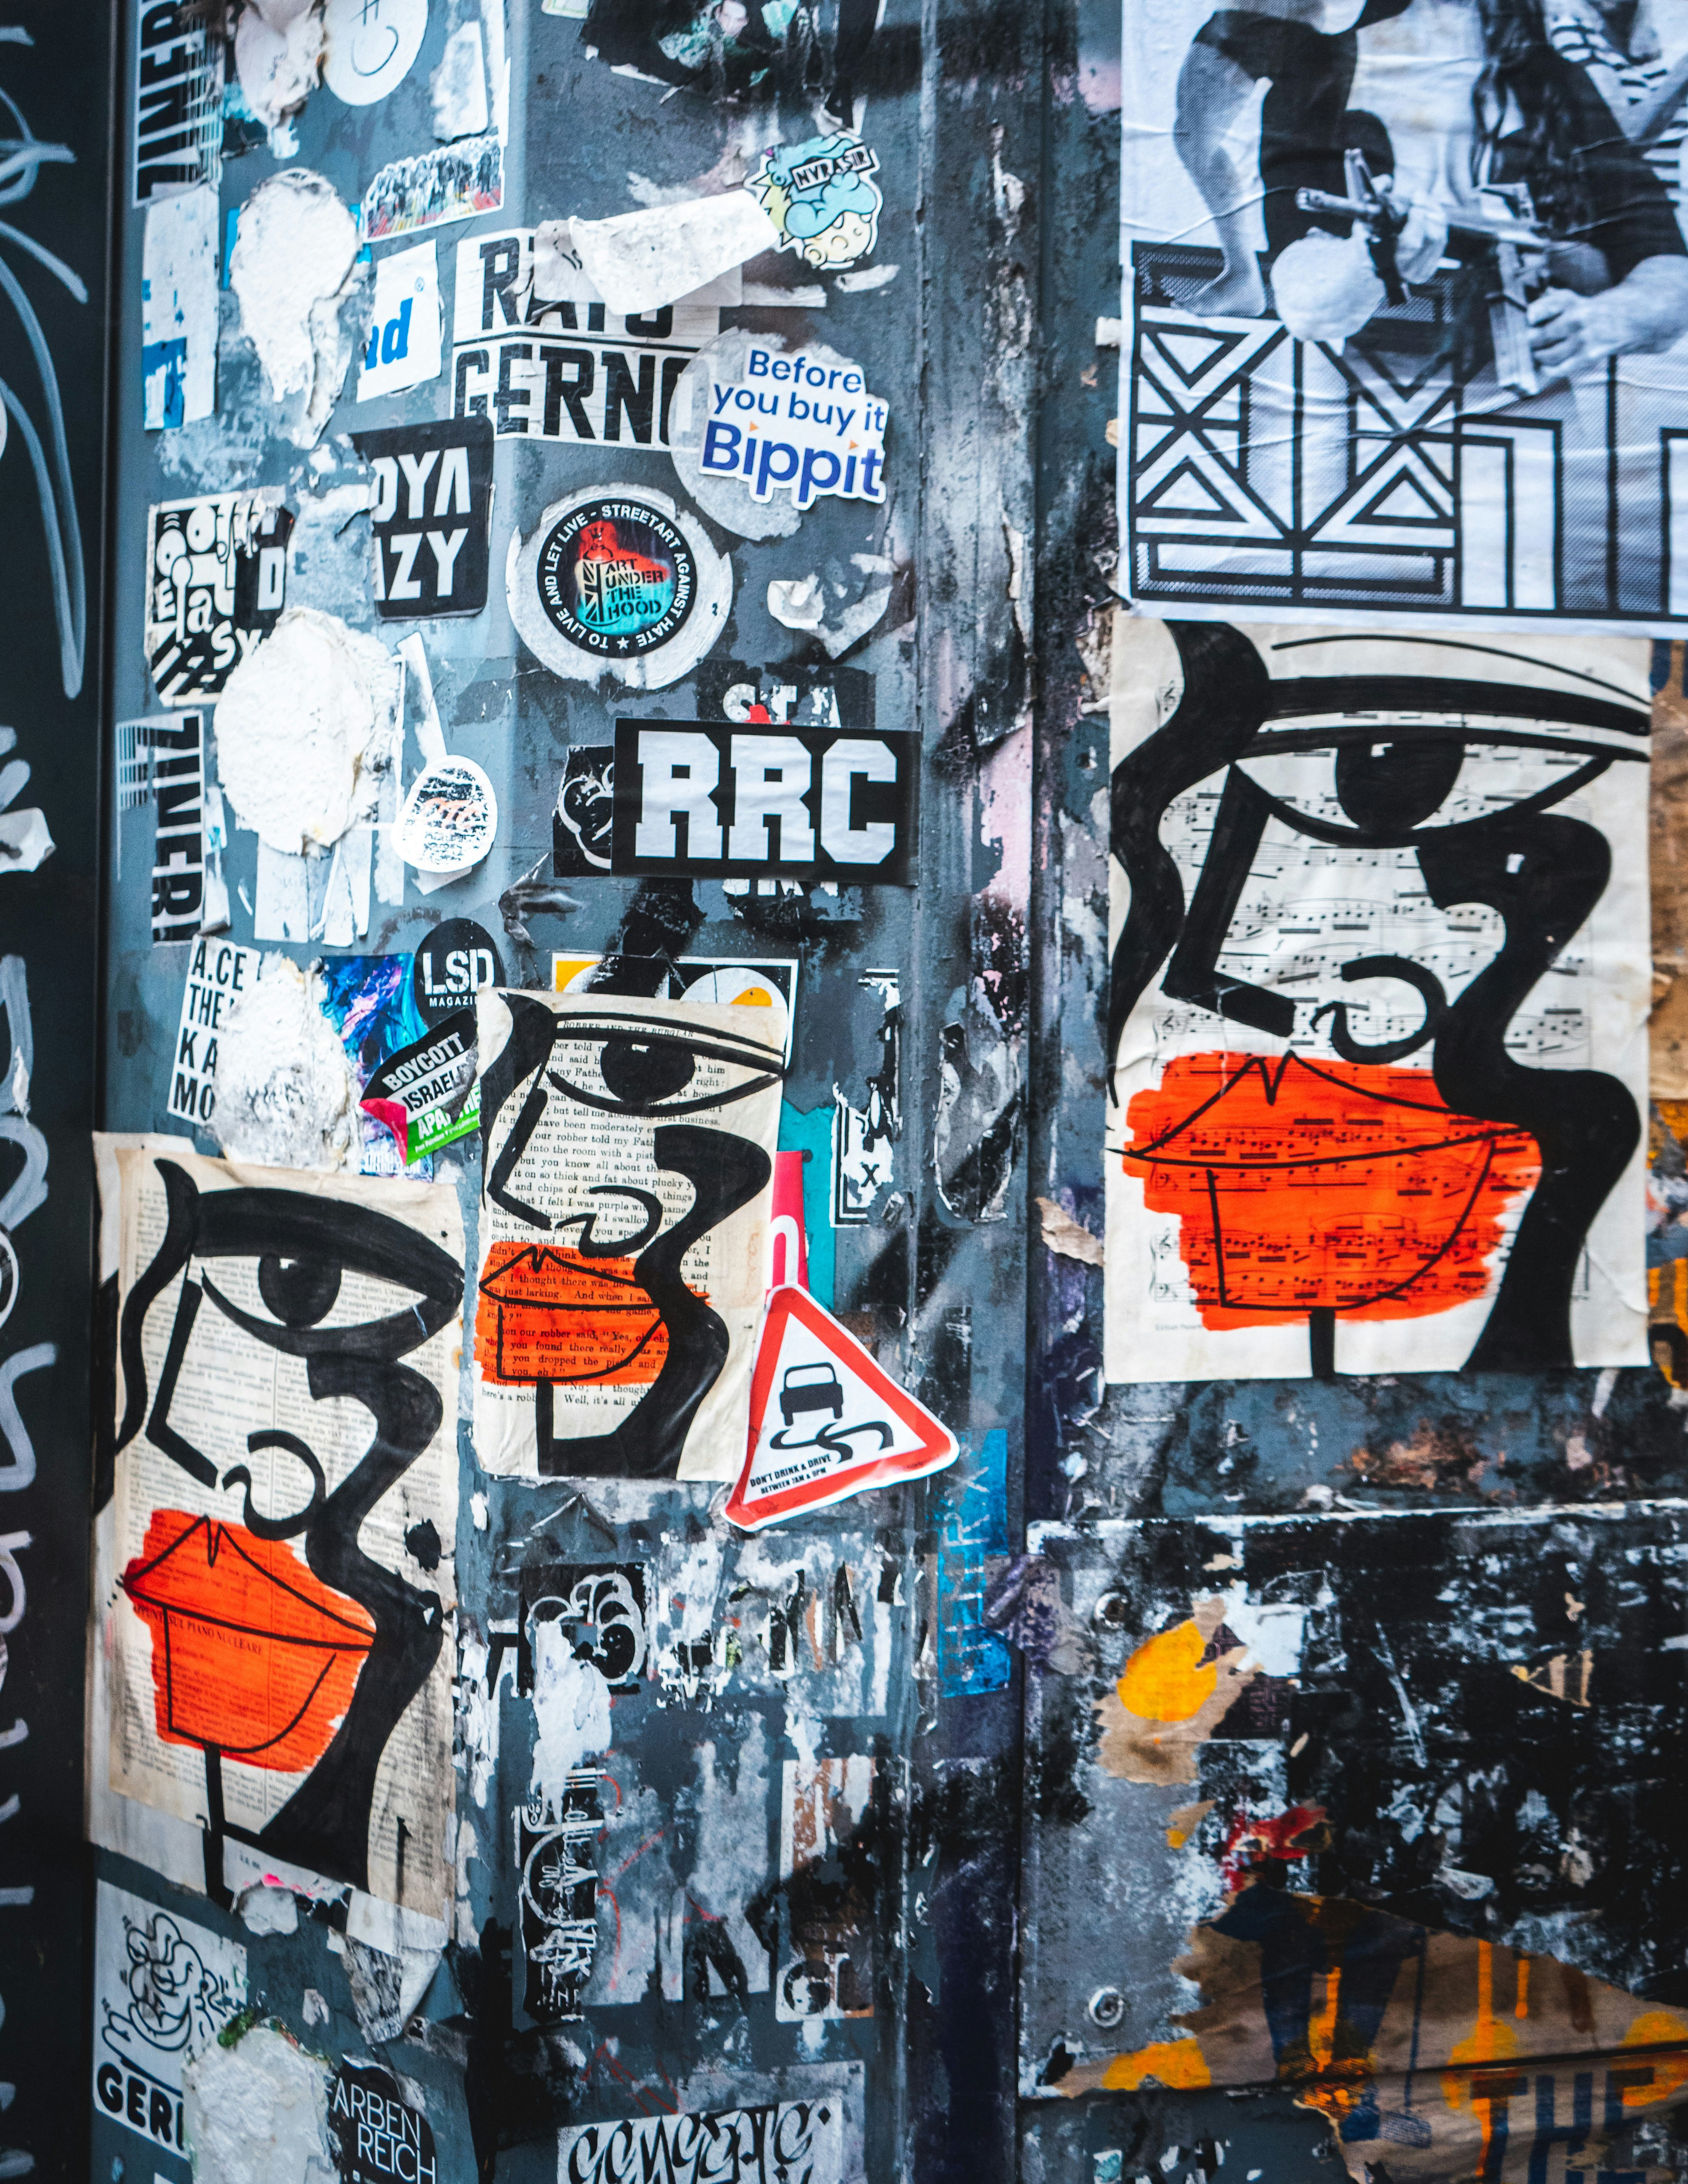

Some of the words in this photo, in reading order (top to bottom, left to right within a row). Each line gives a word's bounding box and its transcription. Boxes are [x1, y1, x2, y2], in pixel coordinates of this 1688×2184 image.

[749, 349, 862, 393] Before
[714, 383, 779, 415] you
[788, 391, 856, 437] buy
[864, 402, 885, 432] it
[703, 420, 884, 503] Bippit
[557, 512, 589, 543] LIVE
[601, 504, 682, 549] STREETART
[544, 541, 563, 572] LET
[605, 558, 638, 575] ART
[606, 569, 664, 589] UNDER
[670, 552, 691, 619] AGAINST
[544, 575, 563, 606] AND
[607, 586, 641, 603] THE
[608, 600, 661, 619] HOOD
[556, 607, 587, 639] LIVE
[635, 617, 674, 647] HATE
[588, 634, 609, 649] TO
[635, 730, 897, 864] RRC
[423, 948, 495, 995] LSD
[574, 1042, 592, 1051] told
[382, 1032, 465, 1092] BOYCOTT
[569, 1054, 588, 1063] said
[575, 1067, 602, 1077] Fathe
[707, 1064, 725, 1073] him
[582, 1081, 593, 1090] he
[550, 1094, 567, 1102] can
[498, 1114, 506, 1123] It
[564, 1119, 585, 1129] been
[590, 1121, 644, 1135] moderately
[554, 1106, 569, 1115] but
[573, 1107, 589, 1116] tell
[679, 1114, 721, 1126] business.
[556, 1132, 587, 1143] robber
[592, 1135, 610, 1144] told
[614, 1138, 629, 1147] my
[633, 1137, 655, 1147] Fath
[530, 1143, 549, 1152] into
[553, 1144, 568, 1154] the
[601, 1149, 621, 1158] with
[541, 1159, 559, 1168] you
[565, 1158, 590, 1168] know
[596, 1161, 608, 1170] all
[614, 1162, 640, 1171] about
[514, 1168, 521, 1177] it
[554, 1172, 579, 1181] thick
[582, 1174, 600, 1182] and
[604, 1174, 618, 1183] fat
[622, 1175, 648, 1186] about
[652, 1178, 684, 1190] plucky
[515, 1182, 532, 1191] and
[538, 1183, 563, 1195] chips
[568, 1185, 578, 1193] of
[663, 1190, 692, 1202] things
[539, 1196, 544, 1204] I
[548, 1196, 564, 1206] felt
[567, 1198, 572, 1206] I
[598, 1201, 629, 1211] purple
[492, 1219, 509, 1228] that
[514, 1221, 534, 1230] tries
[595, 1228, 613, 1237] you
[604, 1213, 608, 1221] I
[612, 1215, 649, 1224] swallow
[520, 1235, 532, 1244] to,
[538, 1236, 555, 1245] and
[562, 1236, 566, 1245] I
[706, 1246, 710, 1254] I
[491, 1243, 515, 1256] didn't
[694, 1258, 709, 1267] the
[510, 1274, 515, 1282] I
[519, 1274, 557, 1286] thought
[562, 1276, 587, 1286] there
[690, 1271, 708, 1280] and
[505, 1287, 522, 1298] just
[526, 1287, 562, 1299] larking.
[574, 1290, 594, 1299] And
[598, 1291, 623, 1301] when
[630, 1293, 633, 1301] I
[540, 1328, 571, 1338] robber
[576, 1330, 598, 1341] said,
[511, 1342, 527, 1351] you
[536, 1341, 562, 1351] found
[569, 1342, 594, 1352] there
[599, 1345, 626, 1356] really
[512, 1354, 530, 1364] you
[538, 1354, 576, 1366] dropped
[584, 1356, 599, 1365] the
[638, 1359, 656, 1368] and
[491, 1377, 507, 1387] And
[599, 1383, 603, 1392] I
[482, 1387, 503, 1400] here's
[564, 1394, 589, 1405] Well,
[593, 1396, 608, 1405] it's
[613, 1397, 625, 1406] all
[750, 1473, 773, 1487] DON'T
[774, 1464, 799, 1480] DRINK
[807, 1453, 831, 1468] DRIVE
[760, 1479, 790, 1494] BETWEEN
[216, 1630, 262, 1655] NUCLEARE
[357, 2122, 437, 2184] REICH
